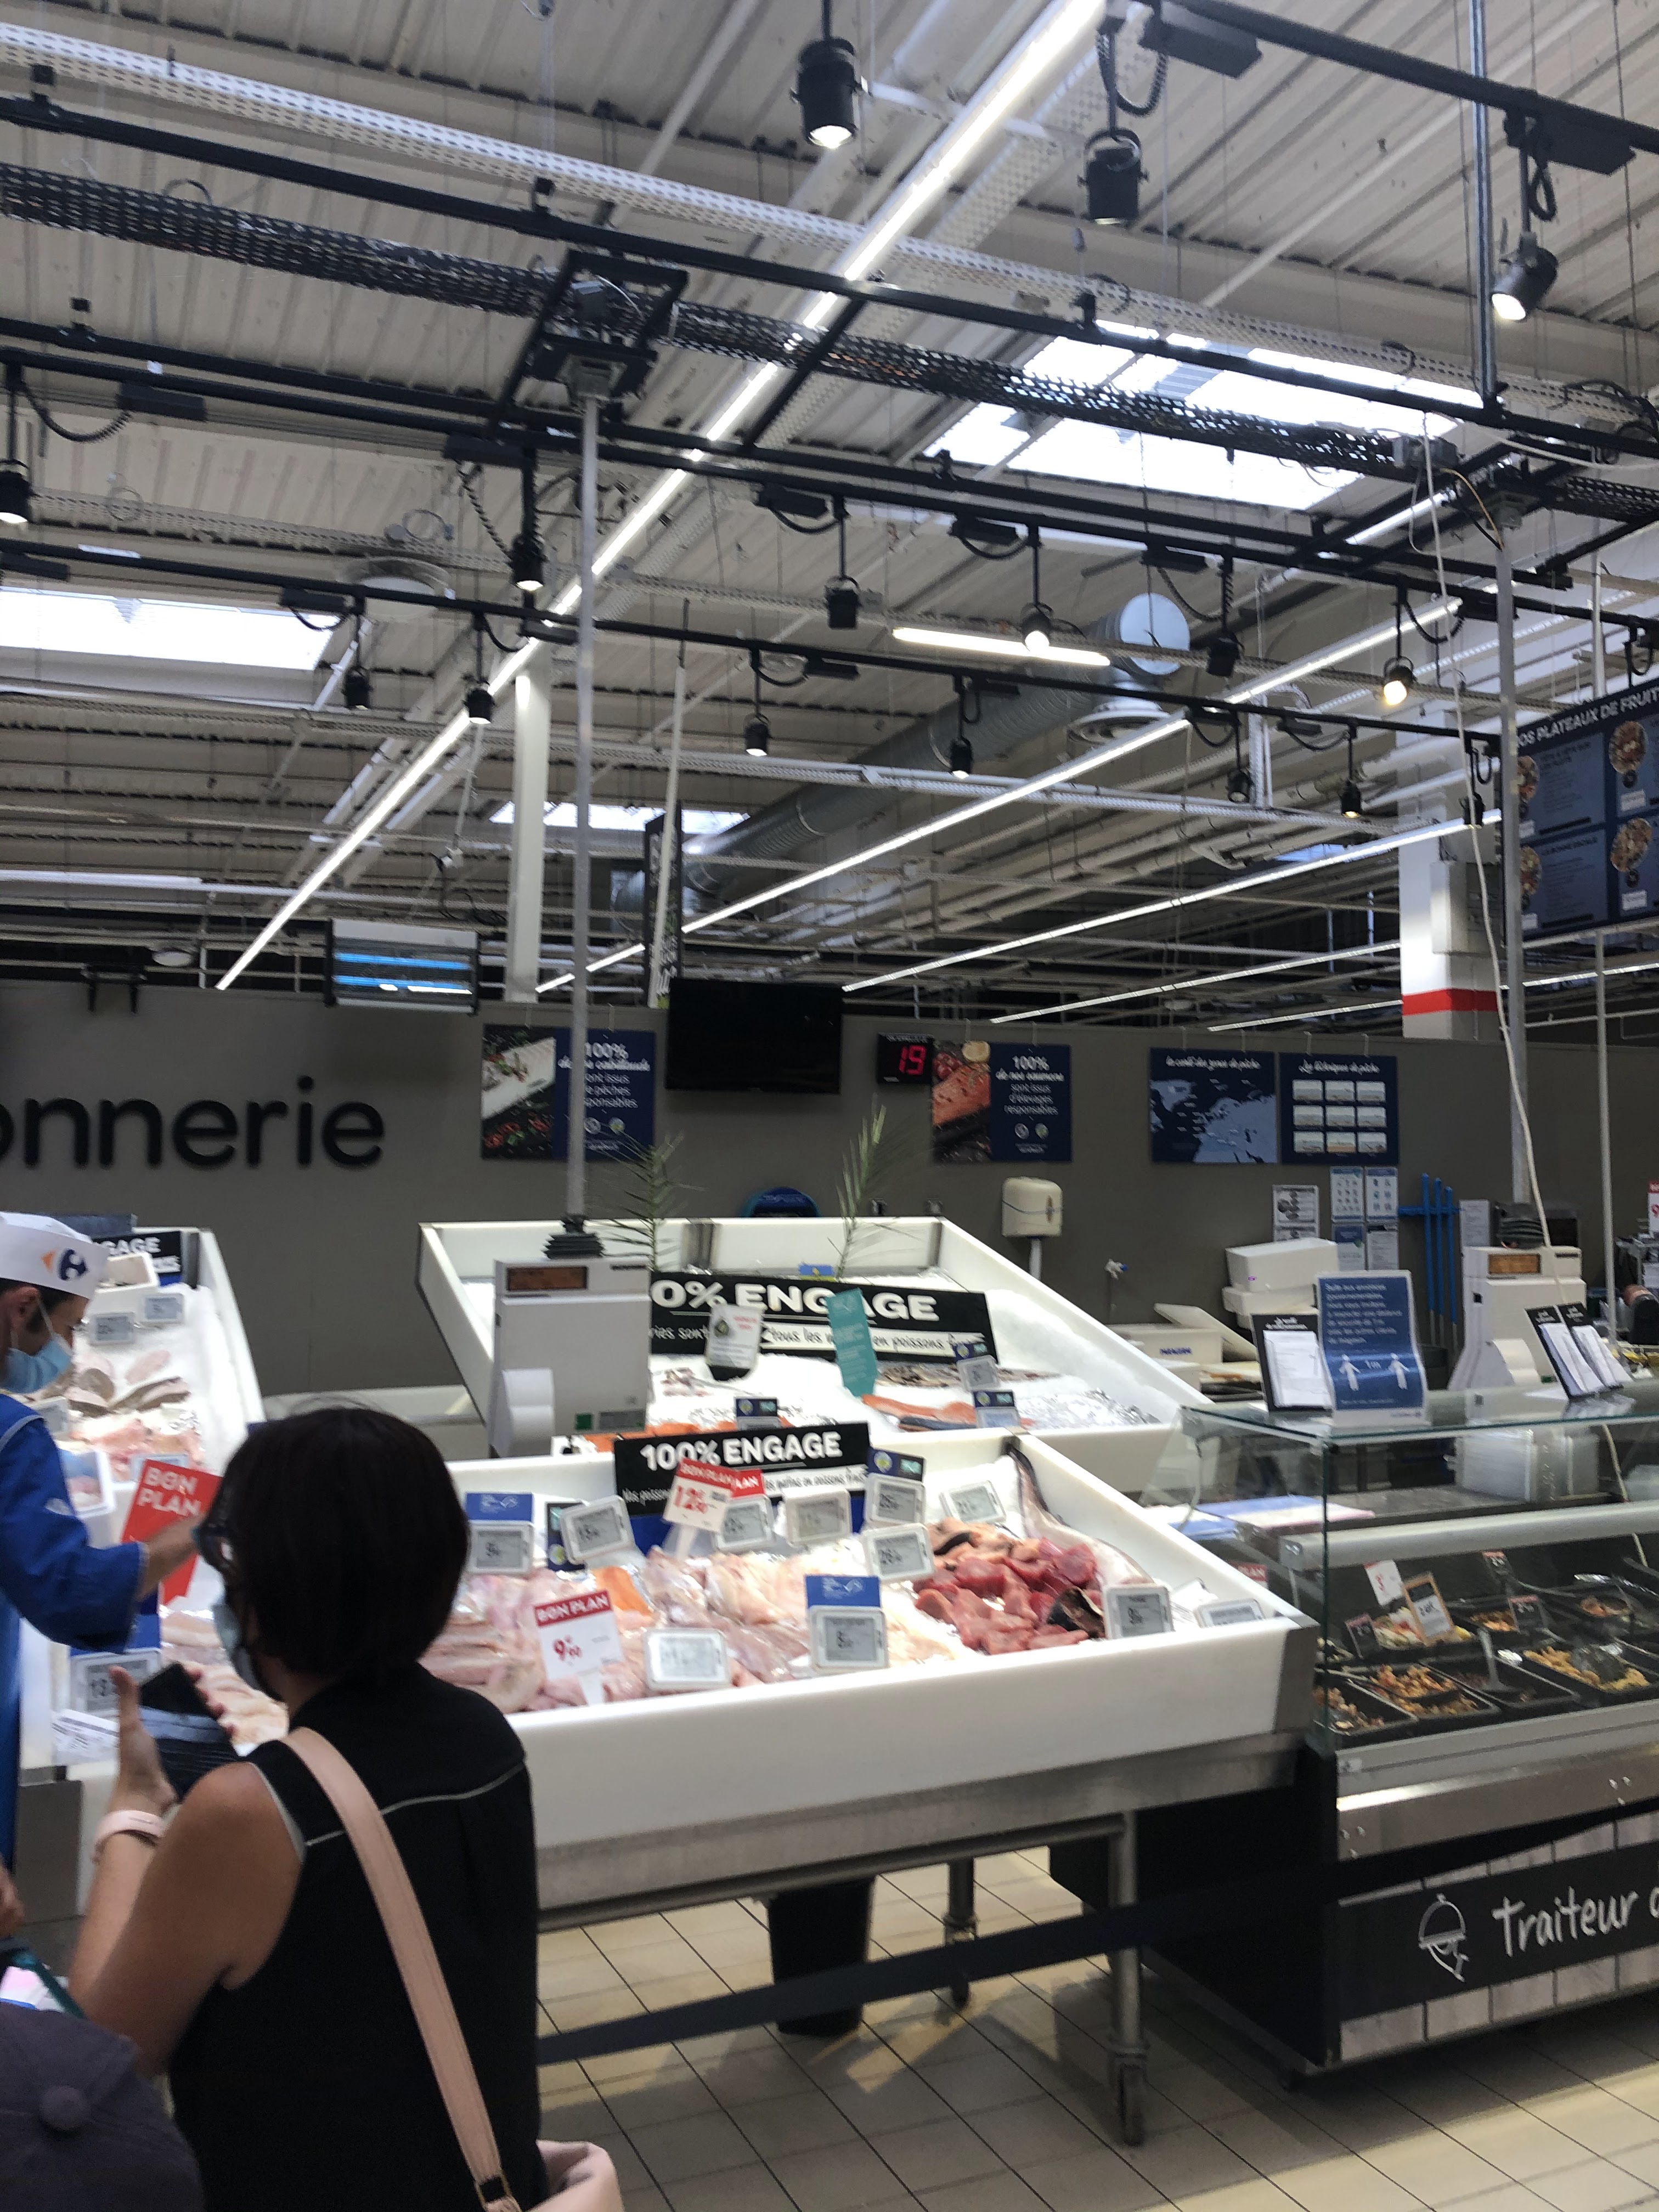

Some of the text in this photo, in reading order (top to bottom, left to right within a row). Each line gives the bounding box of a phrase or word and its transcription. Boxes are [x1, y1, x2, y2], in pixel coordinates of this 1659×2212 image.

[1517, 730, 1536, 747] OS
[1536, 707, 1599, 742] PLATEAUX
[1600, 700, 1619, 719] DE
[898, 1045, 927, 1076] 19
[1012, 1055, 1050, 1071] 100%
[0, 1075, 385, 1169] nnerie
[100, 1237, 161, 1255] GAGE
[651, 1279, 727, 1309] 0%
[640, 1431, 842, 1471] 100% ENGAGE
[1492, 1886, 1639, 1957] Traiteur
